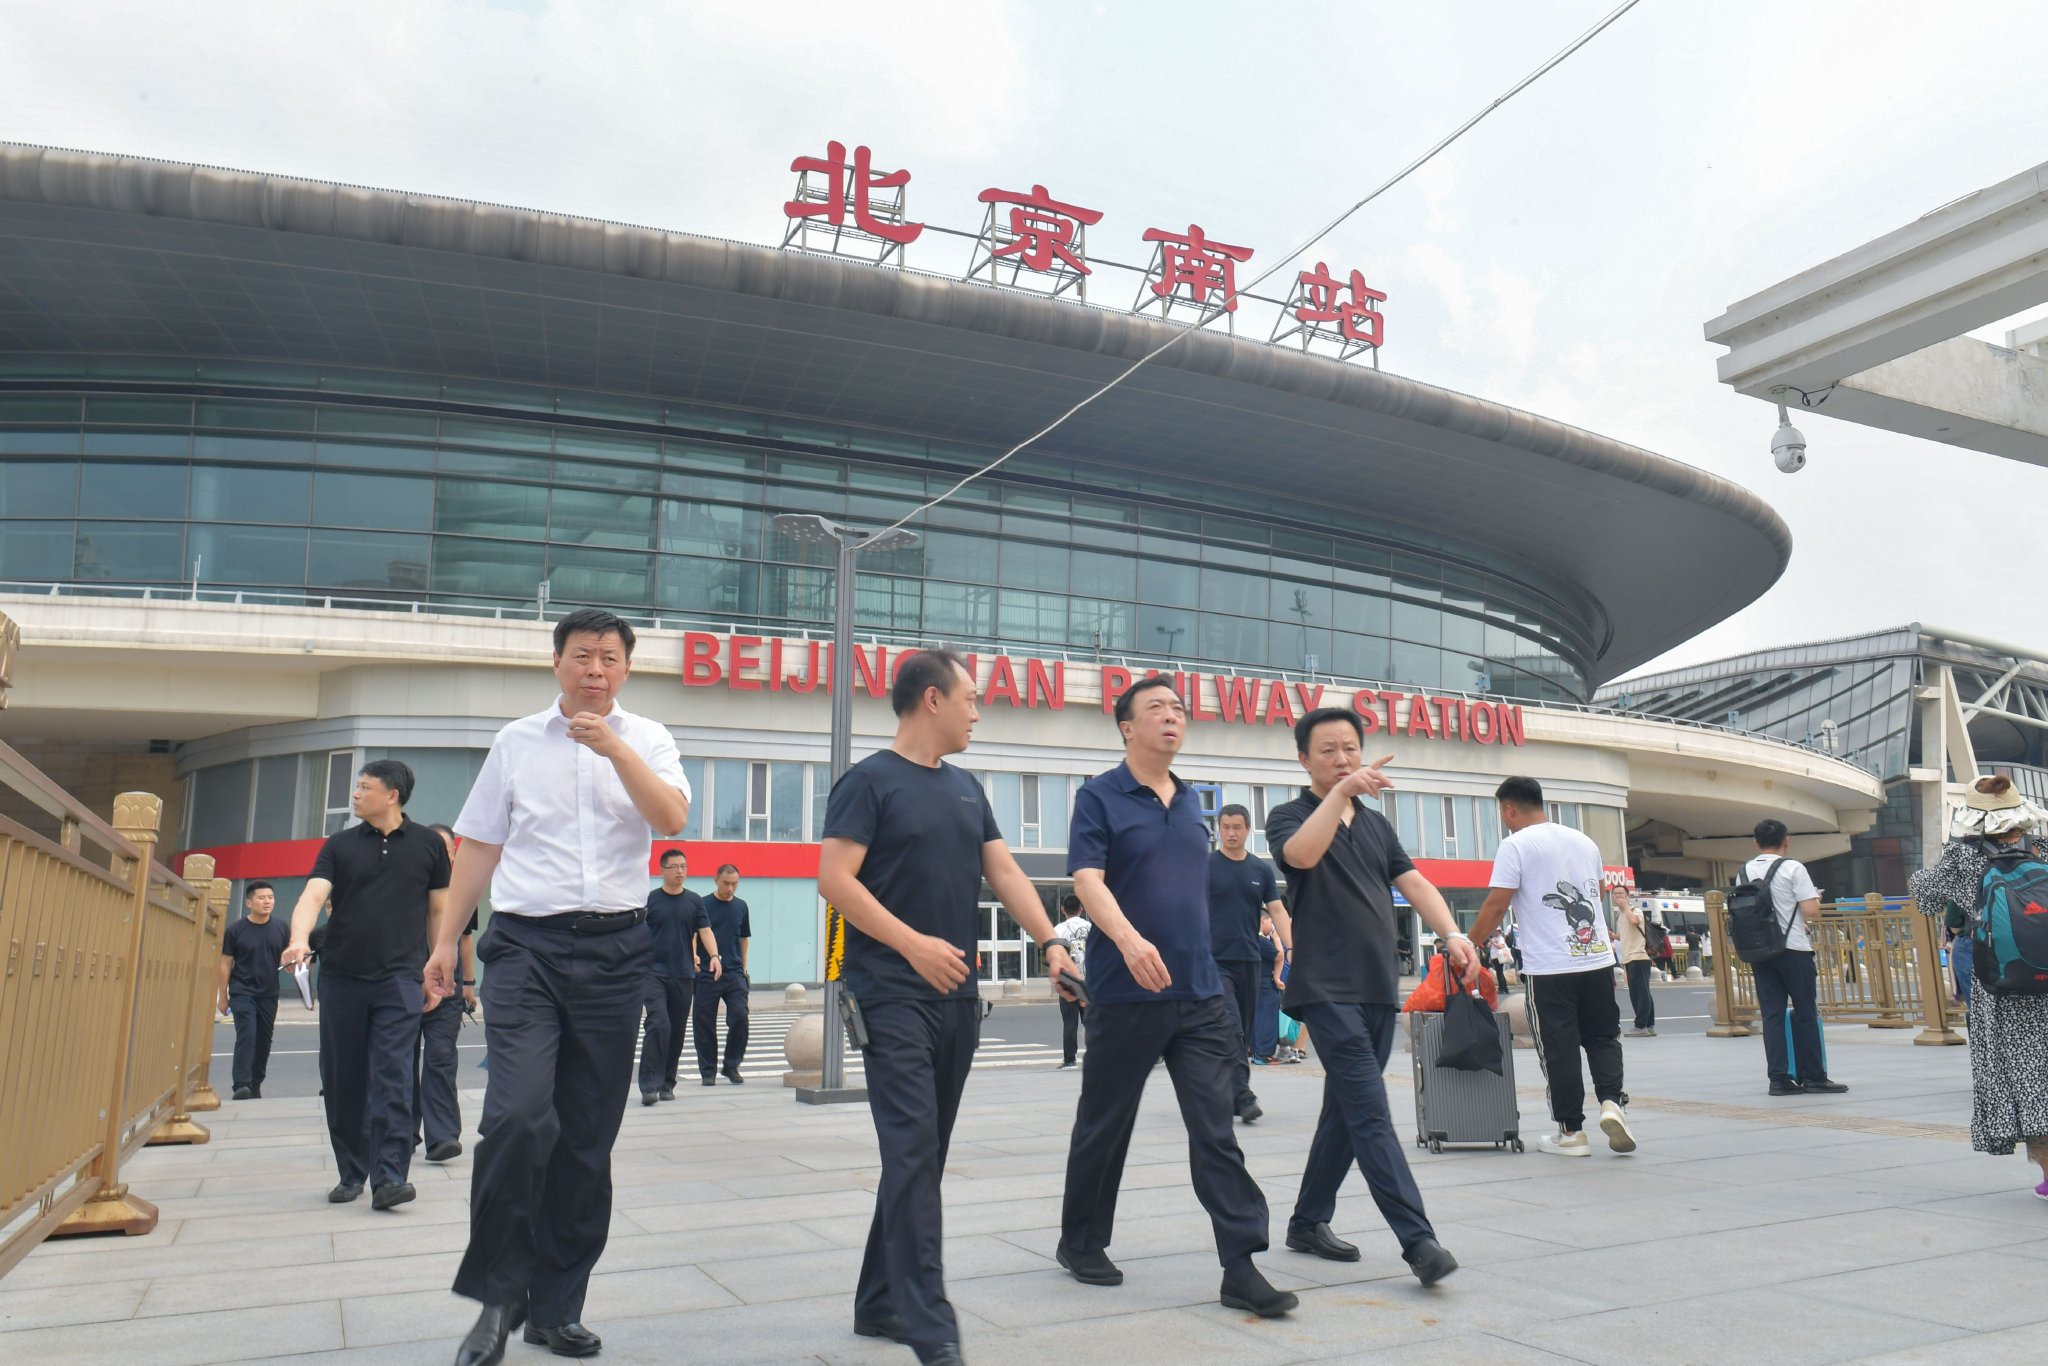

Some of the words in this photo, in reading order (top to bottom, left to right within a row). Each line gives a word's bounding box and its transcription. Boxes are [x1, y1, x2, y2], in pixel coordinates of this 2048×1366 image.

[784, 140, 1387, 347] 北京南站
[683, 631, 1065, 710] BEIJINAN
[1101, 665, 1325, 727] RILWAY
[1353, 689, 1526, 746] STATION
